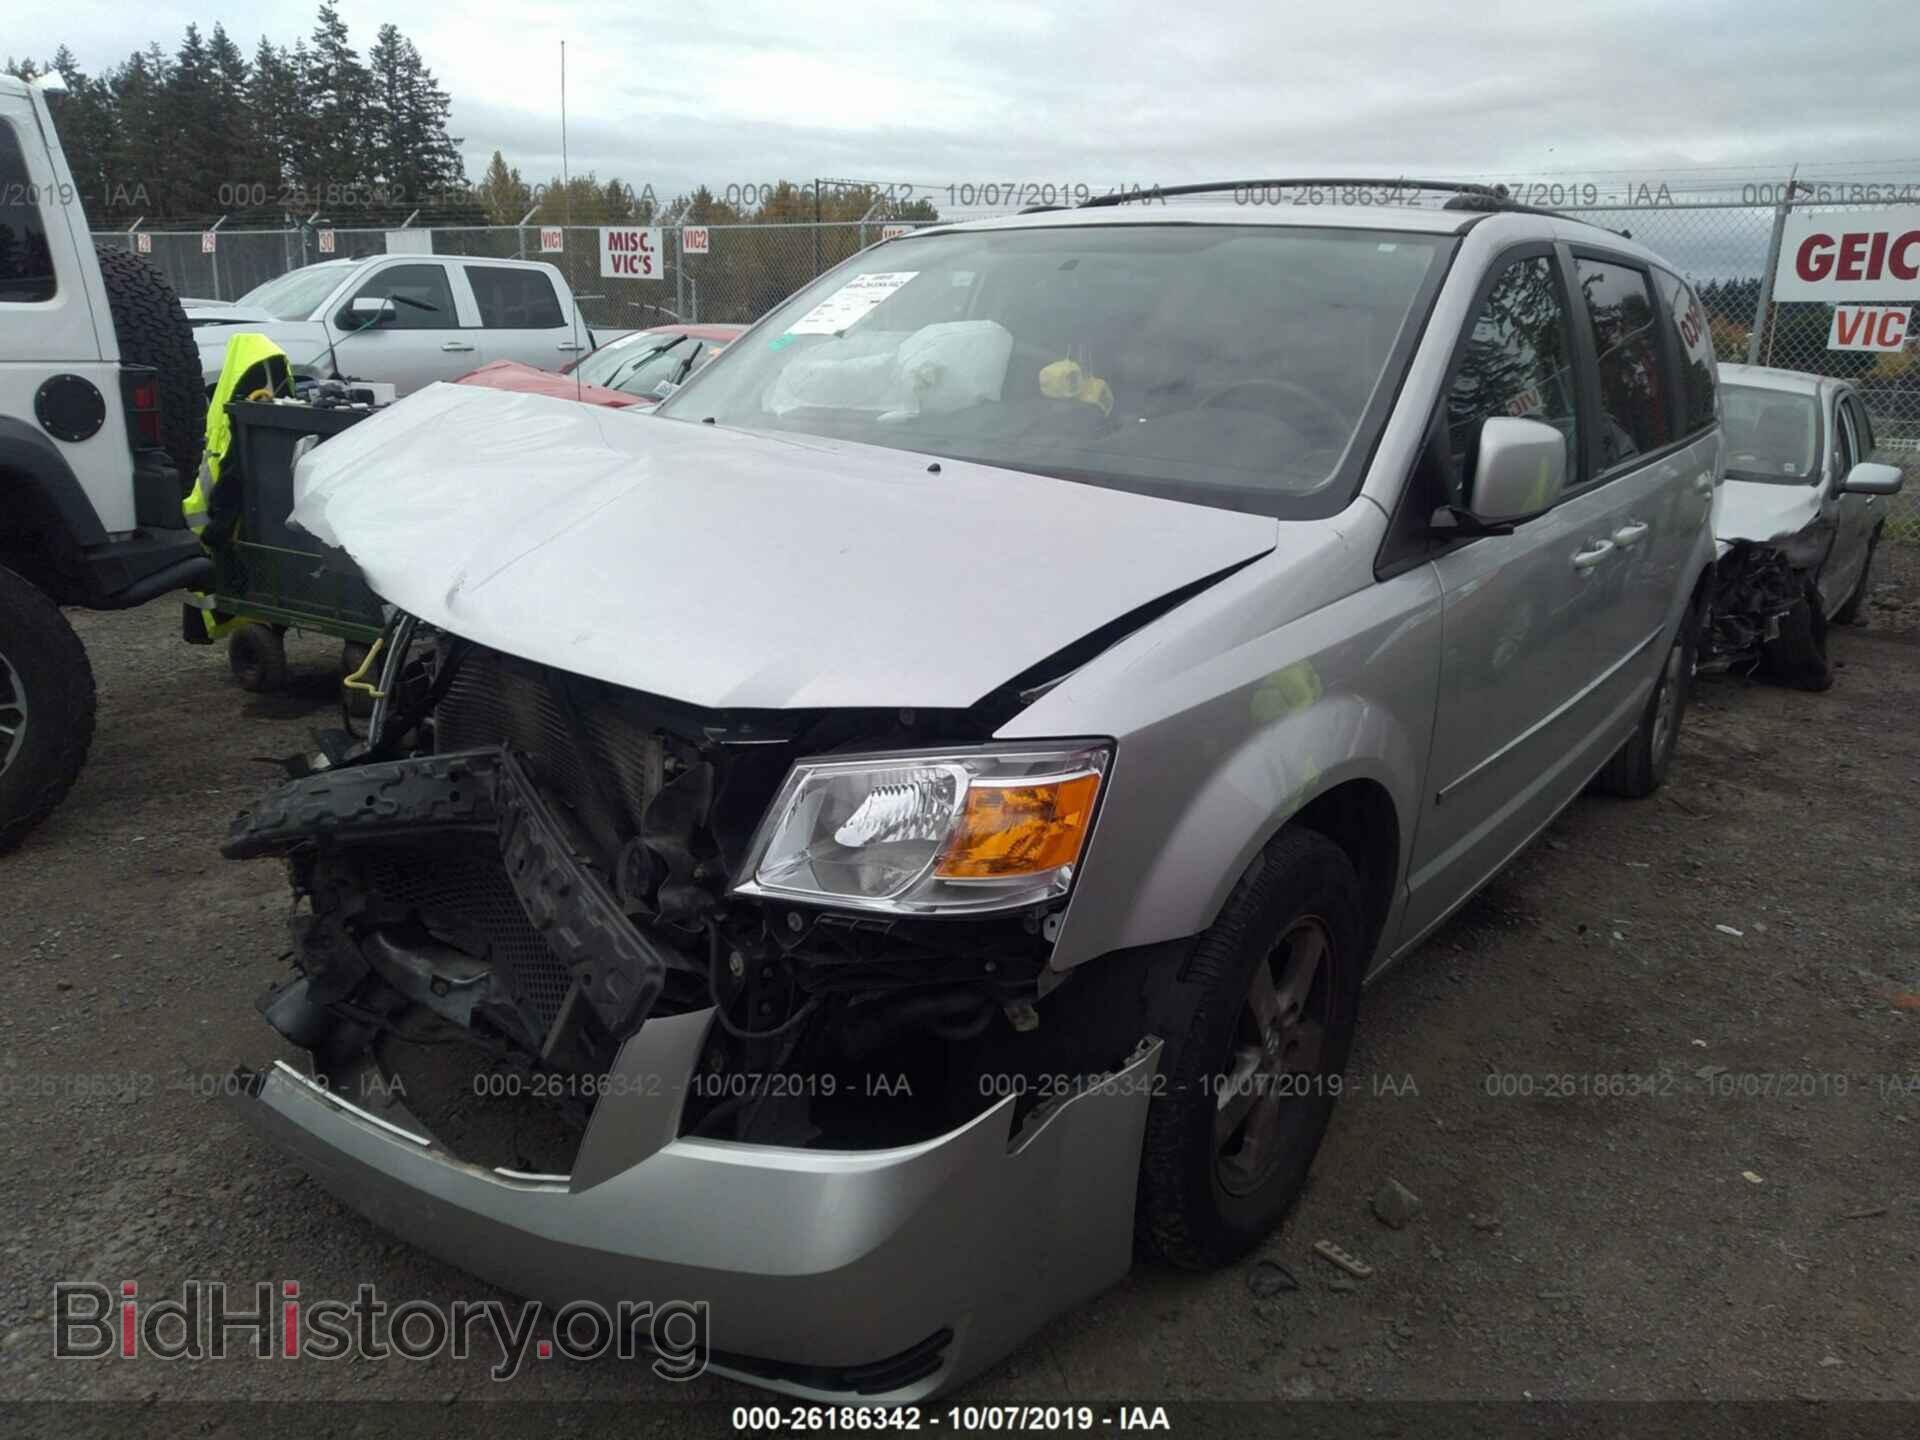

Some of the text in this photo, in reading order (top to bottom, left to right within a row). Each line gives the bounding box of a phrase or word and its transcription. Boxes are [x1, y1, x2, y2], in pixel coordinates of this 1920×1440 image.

[542, 231, 561, 249] VIC1
[608, 232, 654, 252] MISC.
[684, 230, 707, 249] VIC2
[611, 254, 652, 274] VIC'S
[1796, 231, 1920, 282] GEIC
[1837, 310, 1905, 347] VIC
